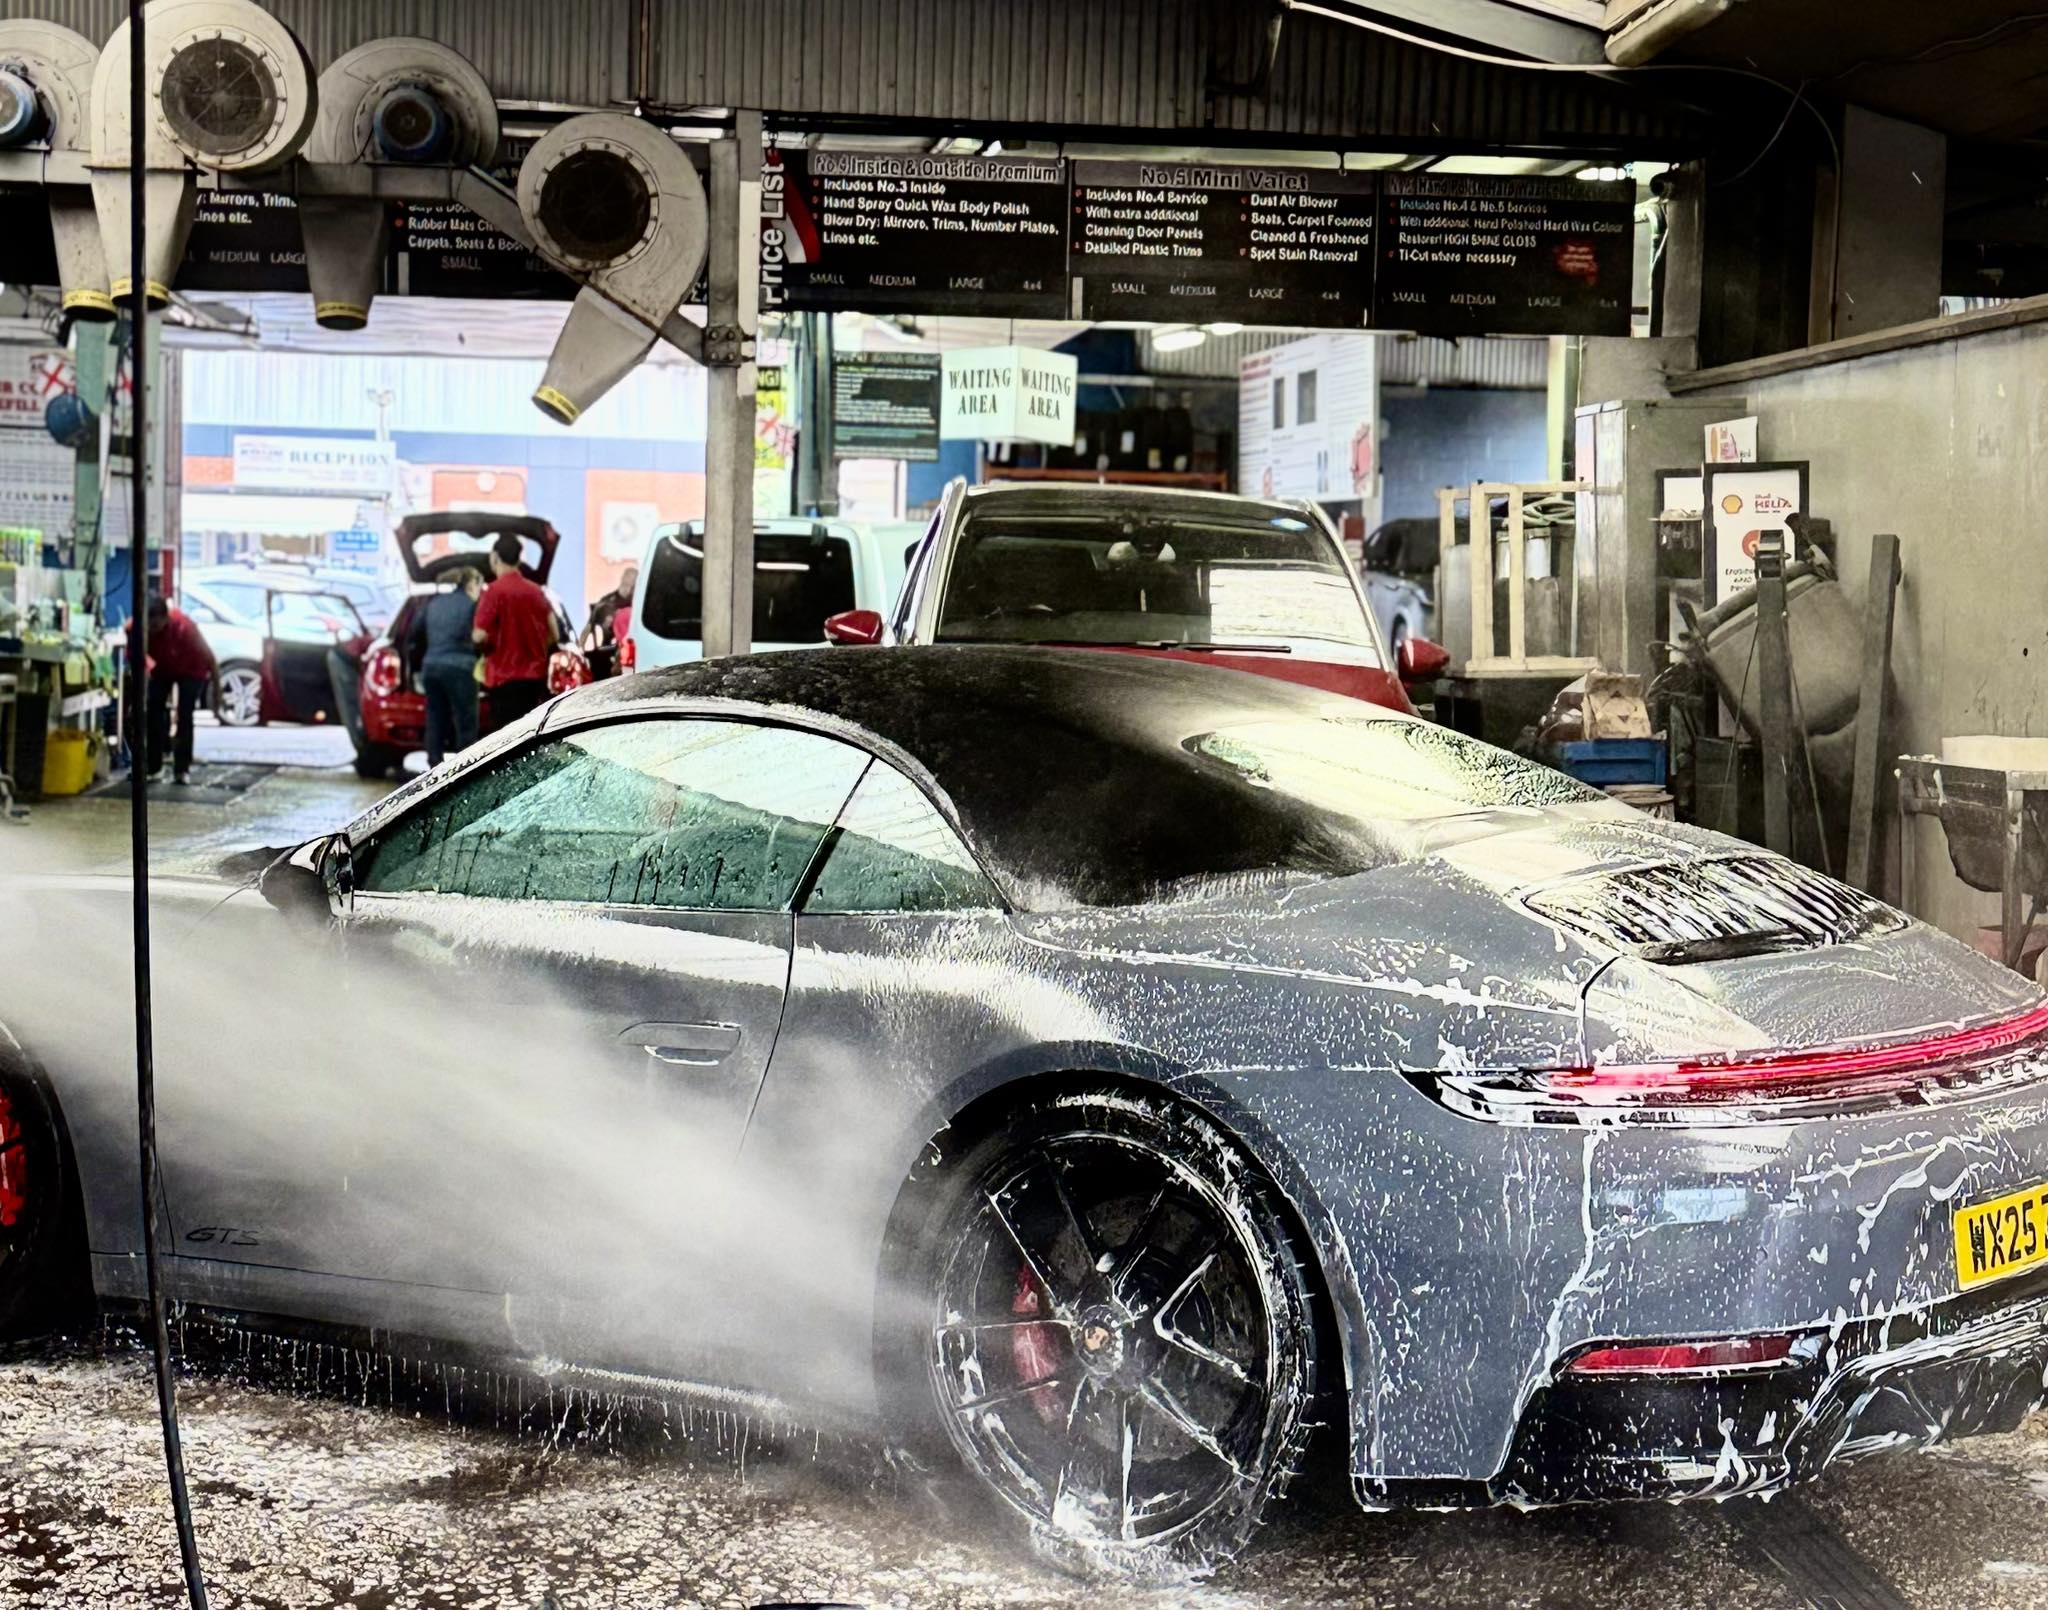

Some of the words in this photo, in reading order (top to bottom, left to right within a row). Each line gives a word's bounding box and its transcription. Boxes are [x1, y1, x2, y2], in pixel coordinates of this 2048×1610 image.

[852, 157, 900, 176] Inside
[904, 159, 916, 176] &
[922, 160, 982, 178] Outside
[988, 162, 1057, 181] Premium
[823, 178, 874, 191] Includes
[877, 180, 908, 193] No.3
[910, 181, 946, 195] Inside
[1191, 168, 1242, 189] Mini
[1248, 171, 1310, 192] Valet
[761, 162, 785, 219] List
[1086, 188, 1133, 202] Includes
[1136, 190, 1165, 203] No.4
[1167, 191, 1209, 205] Service
[823, 195, 855, 209] Hand
[857, 196, 892, 213] Spray
[894, 198, 929, 212] Quick
[931, 199, 957, 212] Wax
[959, 200, 991, 216] Body
[993, 201, 1030, 215] Polish
[1250, 194, 1278, 208] Dust
[1280, 195, 1298, 208] Air
[1299, 195, 1339, 209] Blower
[1399, 198, 1441, 211] Includes
[823, 213, 854, 227] Blow
[971, 218, 1018, 232] Number
[1085, 206, 1112, 220] With
[1113, 207, 1142, 220] extra
[1144, 208, 1200, 222] additional
[1287, 213, 1326, 229] Carpet
[822, 231, 856, 244] Lines
[858, 233, 880, 245] etc.
[1085, 224, 1135, 240] Cleaning
[1137, 225, 1165, 239] Door
[1166, 226, 1204, 240] Panels
[1250, 229, 1298, 244] Cleaned
[1310, 232, 1370, 246] Freshened
[209, 250, 260, 263] MEDIUM
[1085, 241, 1130, 255] Detailed
[1132, 243, 1170, 256] Plastic
[1250, 247, 1277, 262] Spot
[1279, 248, 1308, 262] Stain
[1309, 248, 1358, 263] Removal
[441, 255, 482, 271] SMALL
[1466, 252, 1517, 268] necessary
[809, 273, 845, 286] SMALL
[867, 274, 917, 288] MEDIUM
[949, 276, 985, 290] LARGE
[1111, 282, 1146, 295] SMALL
[1169, 284, 1217, 297] MEDIUM
[1249, 287, 1286, 300] LARGE
[949, 367, 1012, 390] WAITING
[1020, 367, 1072, 397] WAITING
[957, 394, 998, 416] AREA
[1027, 395, 1061, 421] AREA
[289, 450, 390, 466] RECEPTION
[185, 1226, 260, 1246] GTS
